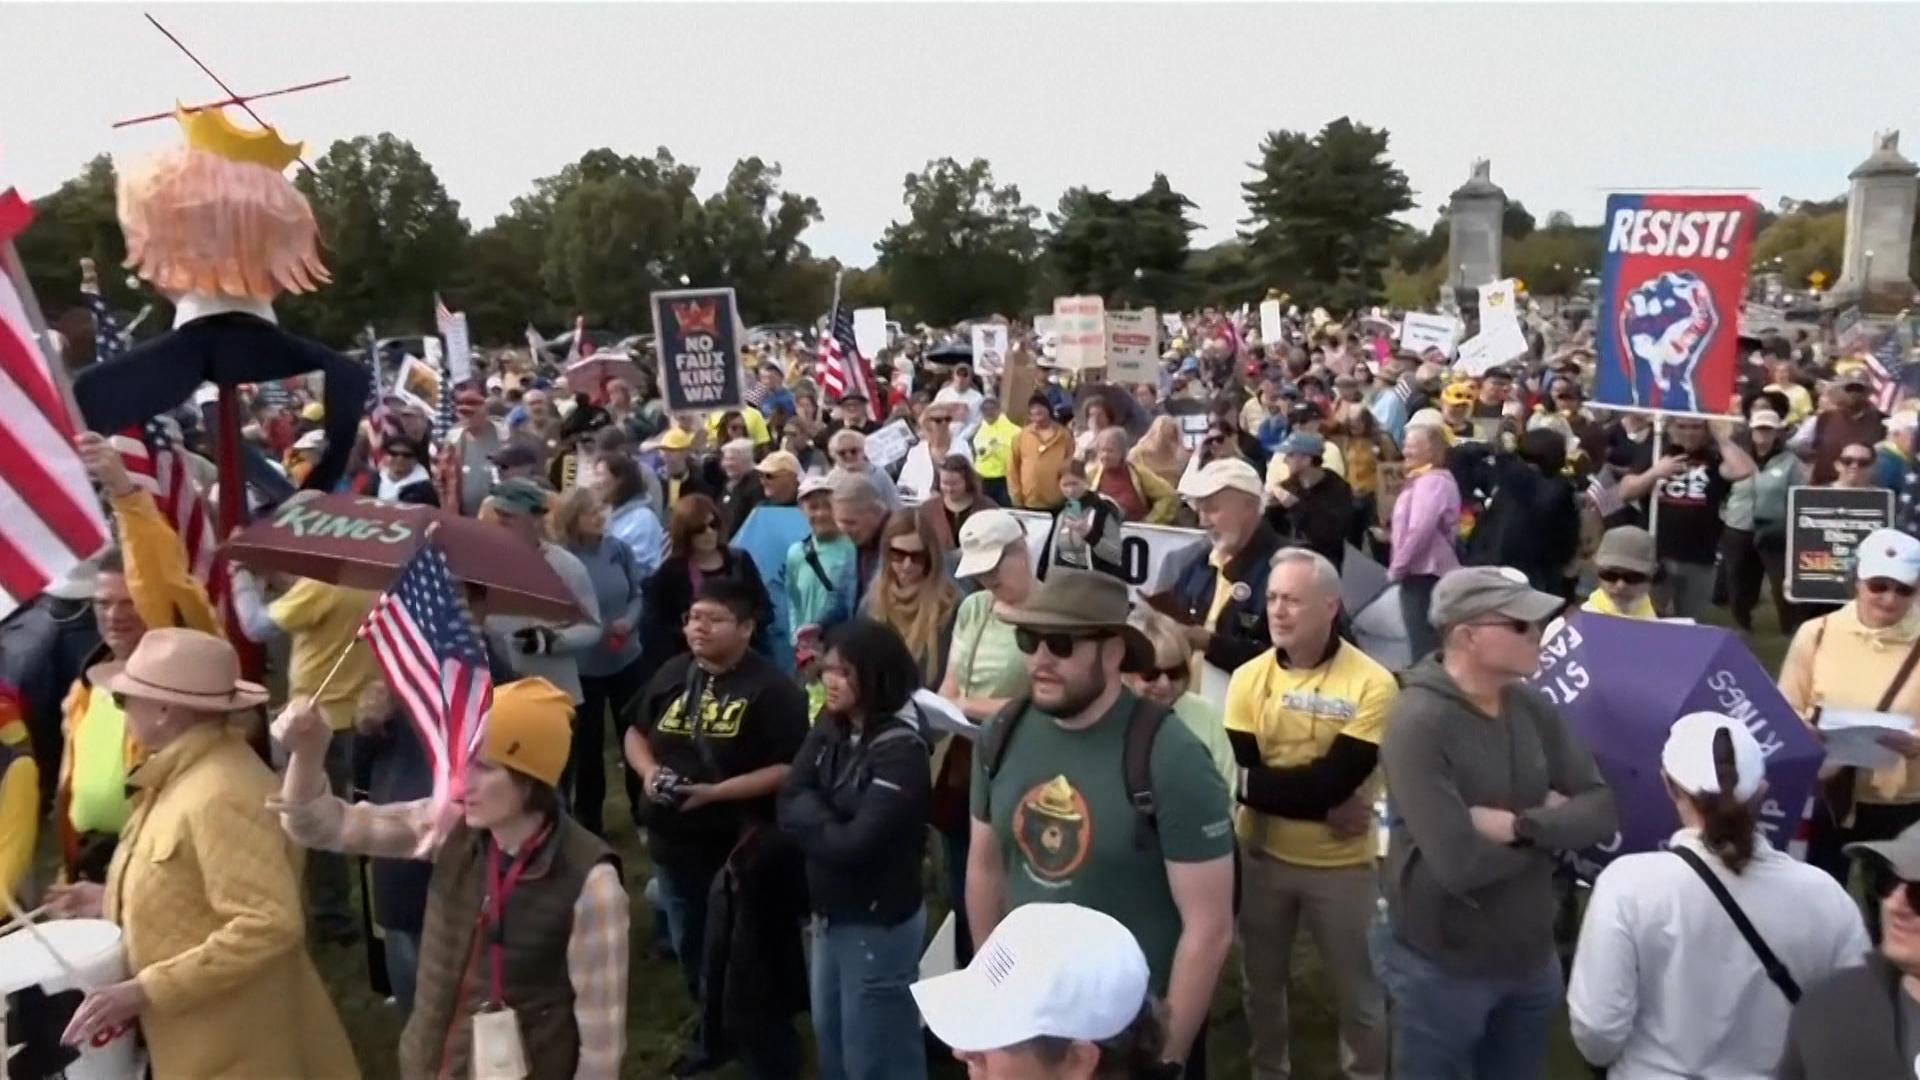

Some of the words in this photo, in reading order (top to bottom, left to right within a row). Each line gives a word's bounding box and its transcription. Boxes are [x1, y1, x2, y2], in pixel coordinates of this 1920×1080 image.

[1608, 209, 1741, 260] RESIST!
[685, 334, 713, 352] NO
[675, 351, 725, 370] FAUX
[679, 368, 725, 386] KING
[683, 385, 724, 402] WAY
[272, 505, 412, 543] KINGS
